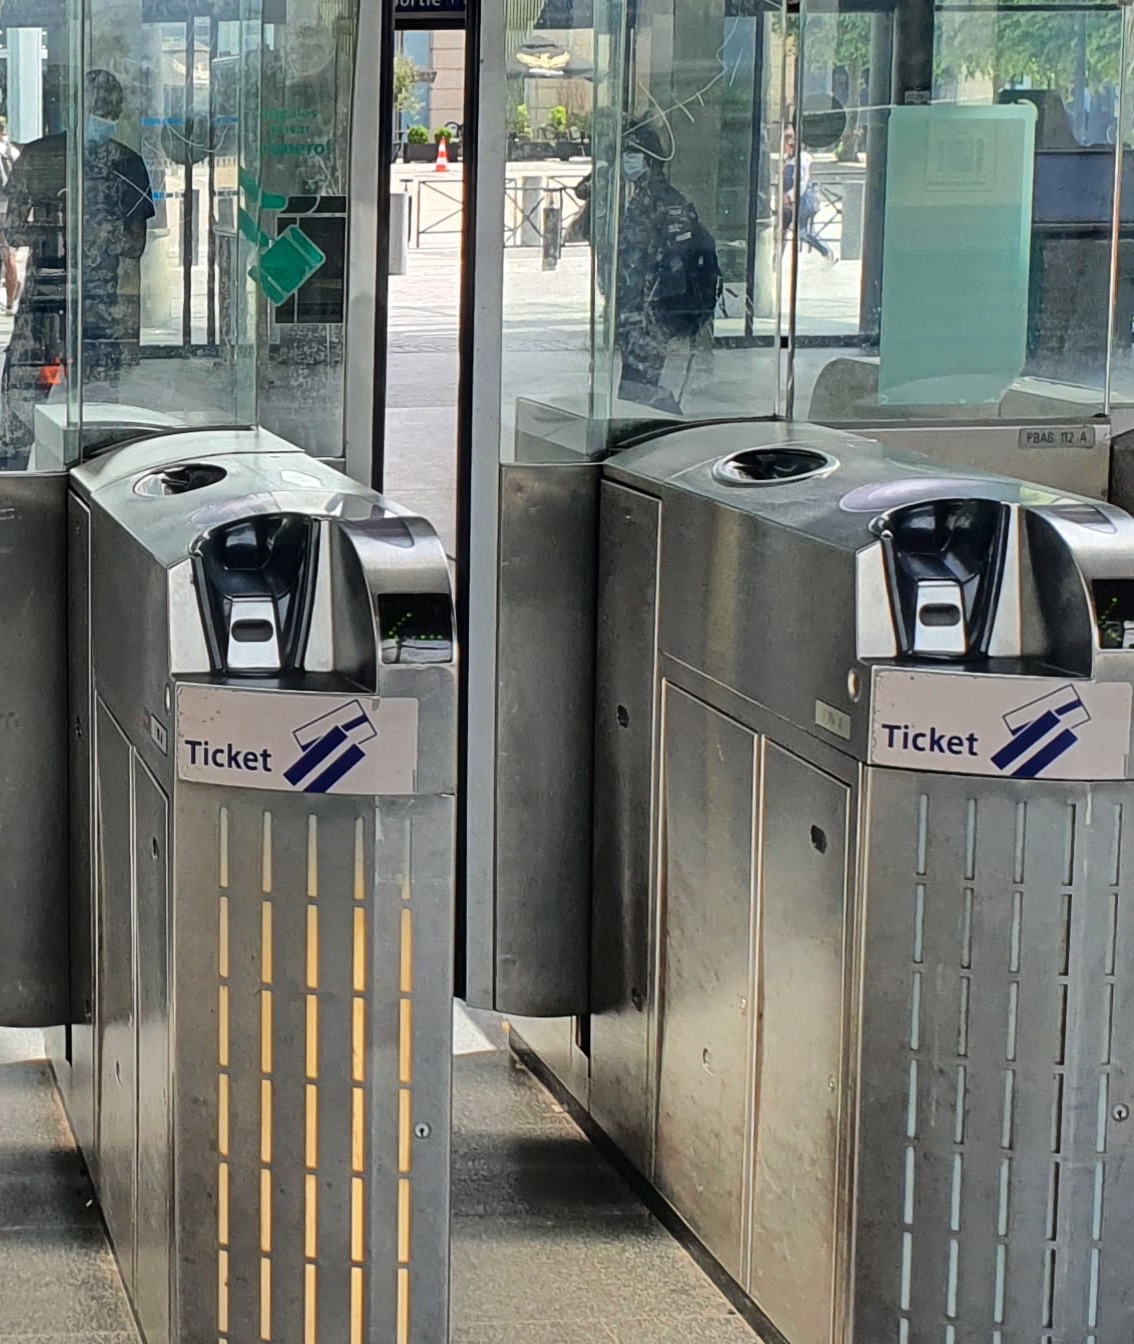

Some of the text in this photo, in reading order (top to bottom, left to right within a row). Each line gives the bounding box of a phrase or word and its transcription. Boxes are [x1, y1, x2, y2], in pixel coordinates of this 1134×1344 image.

[1079, 431, 1087, 442] A
[881, 723, 979, 756] Ticket
[184, 740, 272, 772] Ticket
